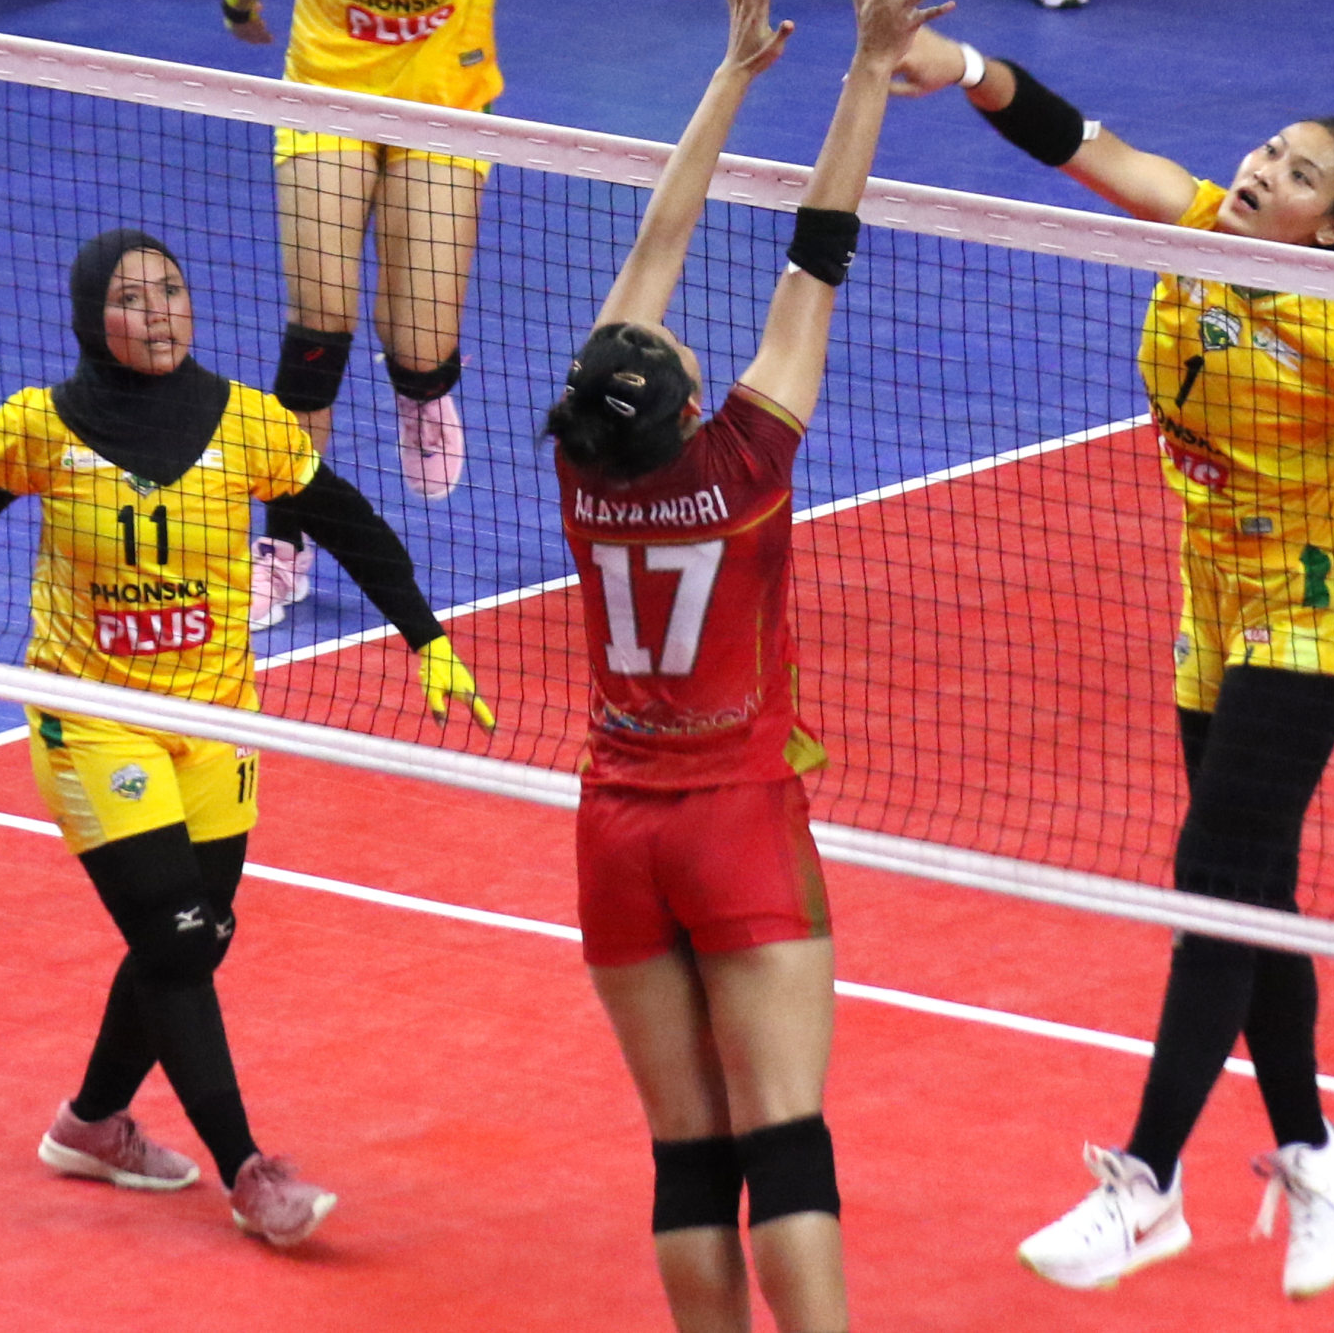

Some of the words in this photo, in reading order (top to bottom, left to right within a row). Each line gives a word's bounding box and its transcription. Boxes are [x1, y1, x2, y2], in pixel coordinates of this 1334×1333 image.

[348, 7, 449, 42] PLUS
[1175, 355, 1205, 408] 1
[118, 505, 168, 565] 11
[90, 579, 210, 603] PHONSKA
[591, 540, 725, 676] 17
[98, 609, 207, 651] PLUS
[236, 760, 255, 803] 11
